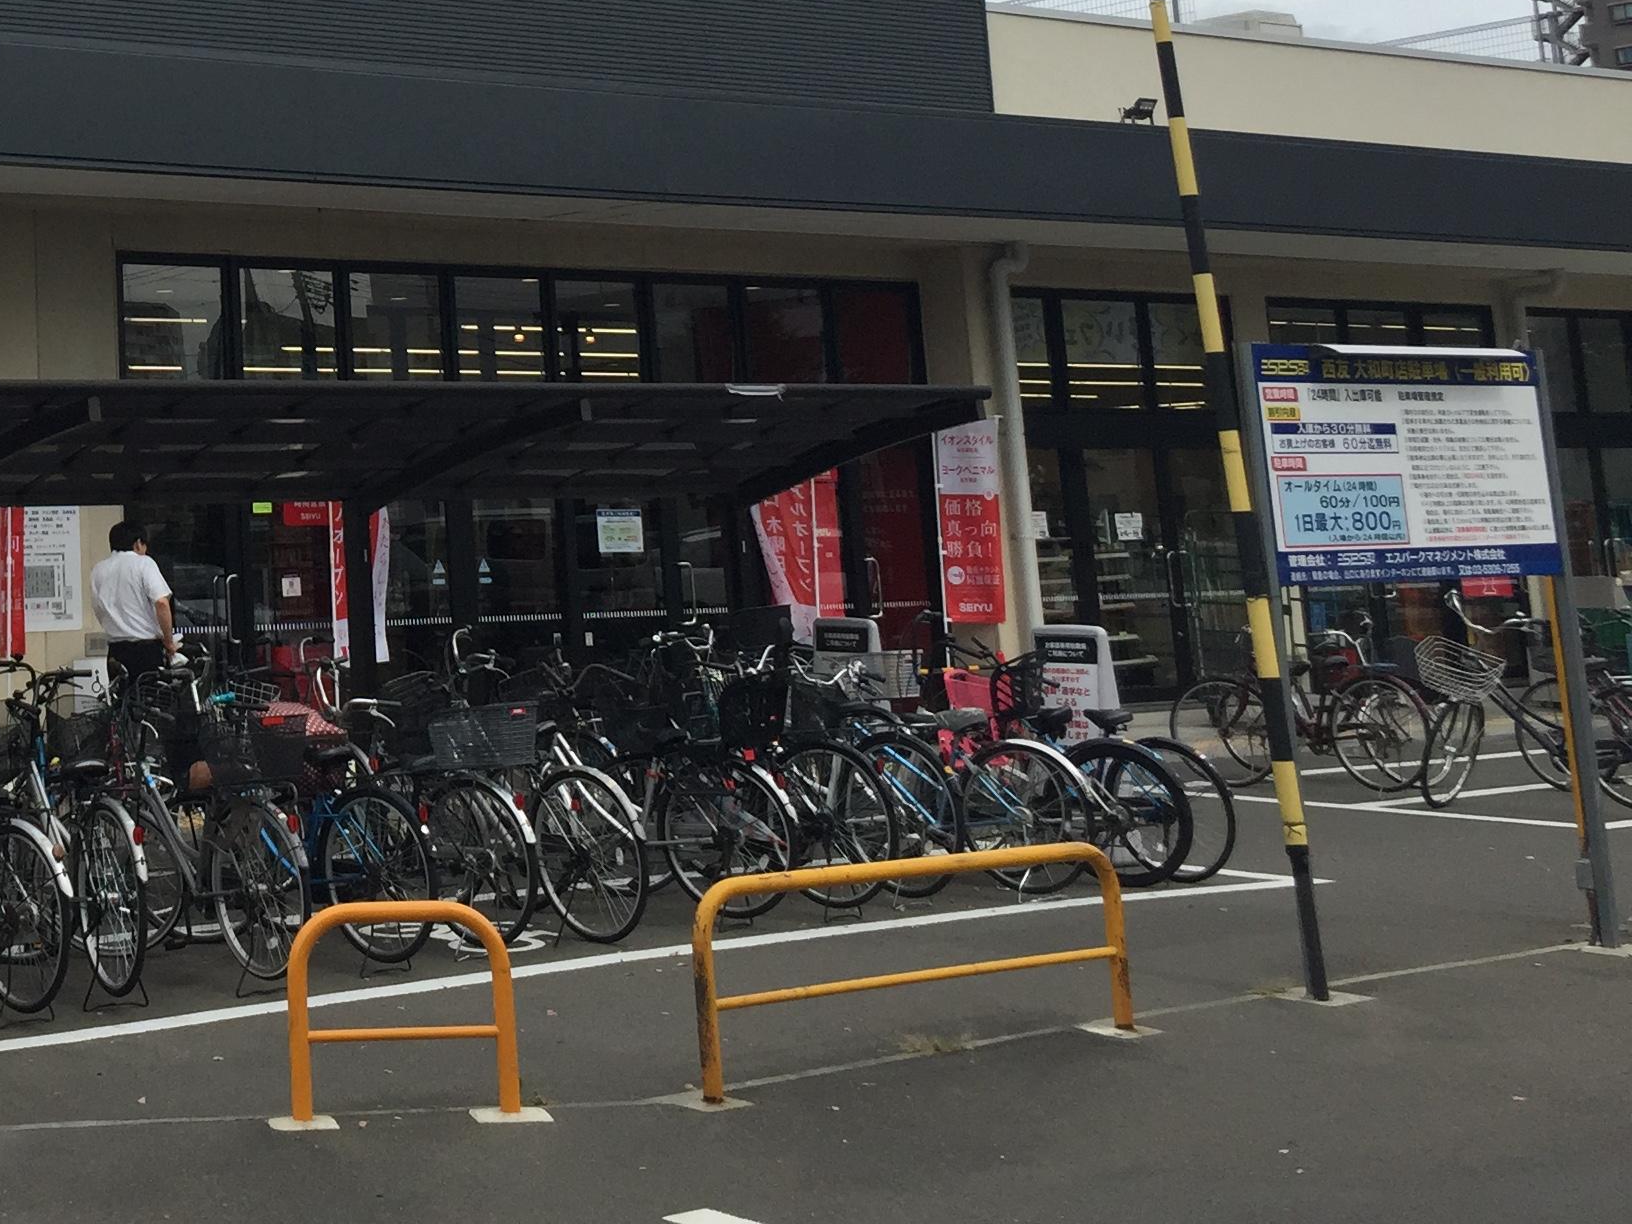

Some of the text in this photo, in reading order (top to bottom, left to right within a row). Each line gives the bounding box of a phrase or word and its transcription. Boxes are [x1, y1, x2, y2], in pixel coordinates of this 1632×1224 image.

[944, 498, 983, 517] 価格
[946, 520, 997, 537] 真っ向
[959, 602, 993, 613] SEIYU
